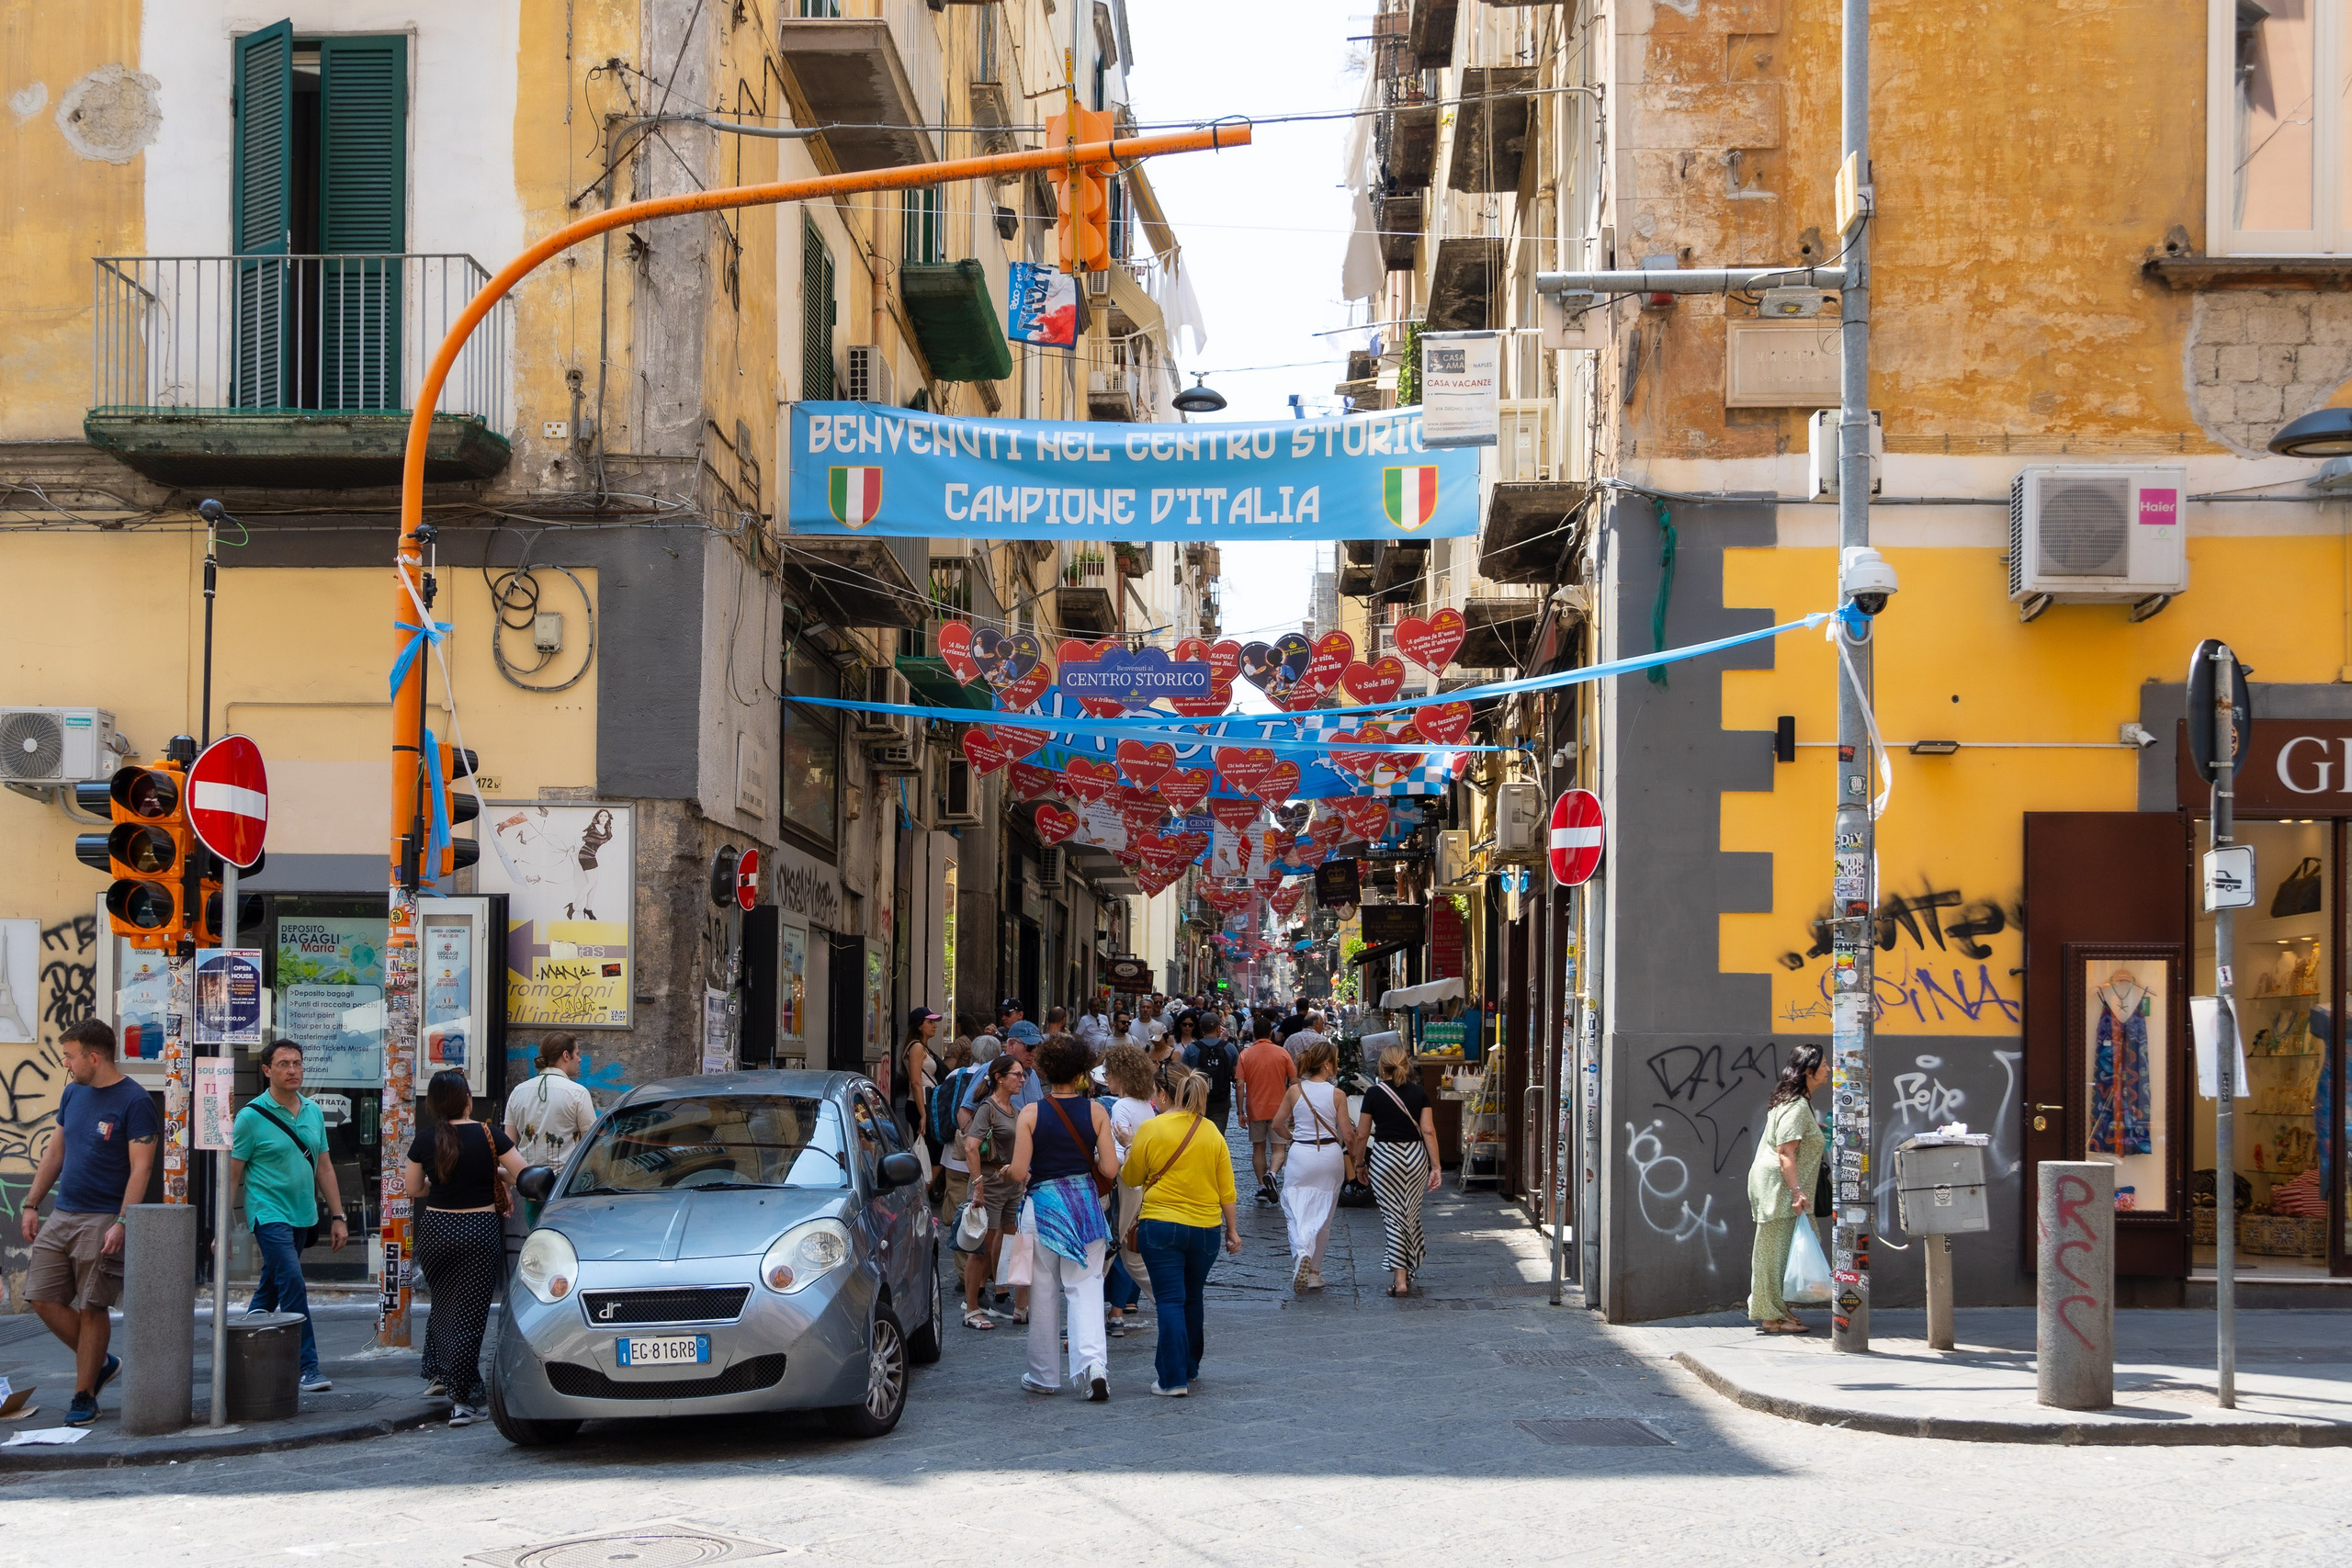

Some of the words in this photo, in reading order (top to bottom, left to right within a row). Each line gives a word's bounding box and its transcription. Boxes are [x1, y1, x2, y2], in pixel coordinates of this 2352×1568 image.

[1453, 378, 1492, 387] VACANZE
[808, 415, 1022, 460] BENVENUTI
[1037, 430, 1110, 461] NEL
[1125, 428, 1276, 461] CENTRO
[1292, 416, 1457, 458] STORIC
[945, 483, 1135, 525] CAMPIONE
[1151, 485, 1319, 525] D'ITALIA
[2140, 502, 2175, 512] Haier
[1066, 672, 1131, 687] CENTRO
[1135, 672, 1205, 687] STORICO
[1363, 680, 1378, 689] Sole
[1380, 678, 1394, 686] Mio
[281, 925, 325, 933] DEPOSITO
[280, 933, 340, 945] BAGAGLI
[301, 942, 335, 953] Maria
[326, 989, 354, 999] bagagli
[352, 1001, 377, 1009] pacchi
[317, 1012, 335, 1020] point
[598, 1301, 622, 1319] dr
[631, 1342, 647, 1360] EG
[652, 1341, 696, 1359] 816RB
